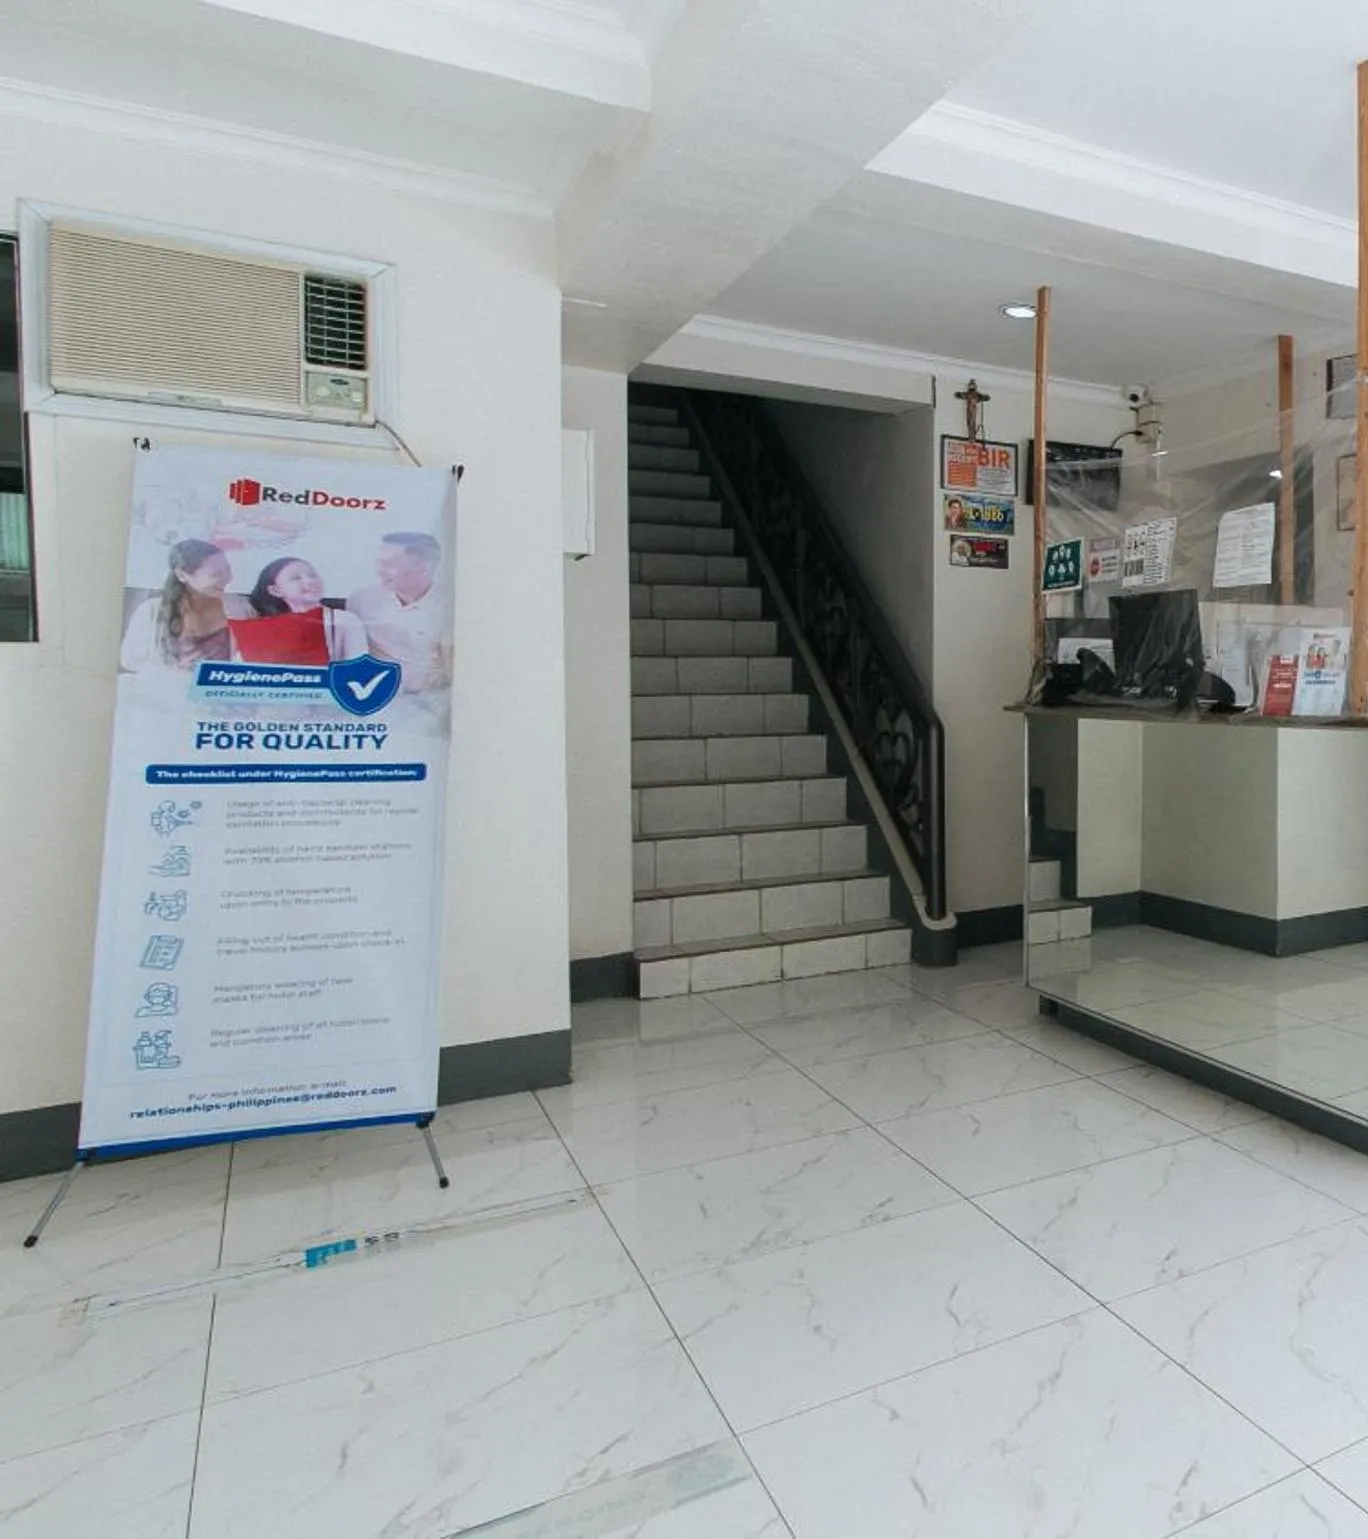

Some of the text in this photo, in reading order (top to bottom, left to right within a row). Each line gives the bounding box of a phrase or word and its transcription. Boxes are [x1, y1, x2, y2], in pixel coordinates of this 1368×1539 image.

[978, 447, 1010, 468] BIR
[262, 485, 386, 510] RedDoorz
[208, 670, 322, 684] HygienePass
[196, 721, 388, 733] THE GOLDEN STANDARD
[196, 733, 388, 751] FOR QUALITY
[156, 770, 179, 778] The
[237, 770, 272, 778] under
[274, 769, 347, 780] HygienePass
